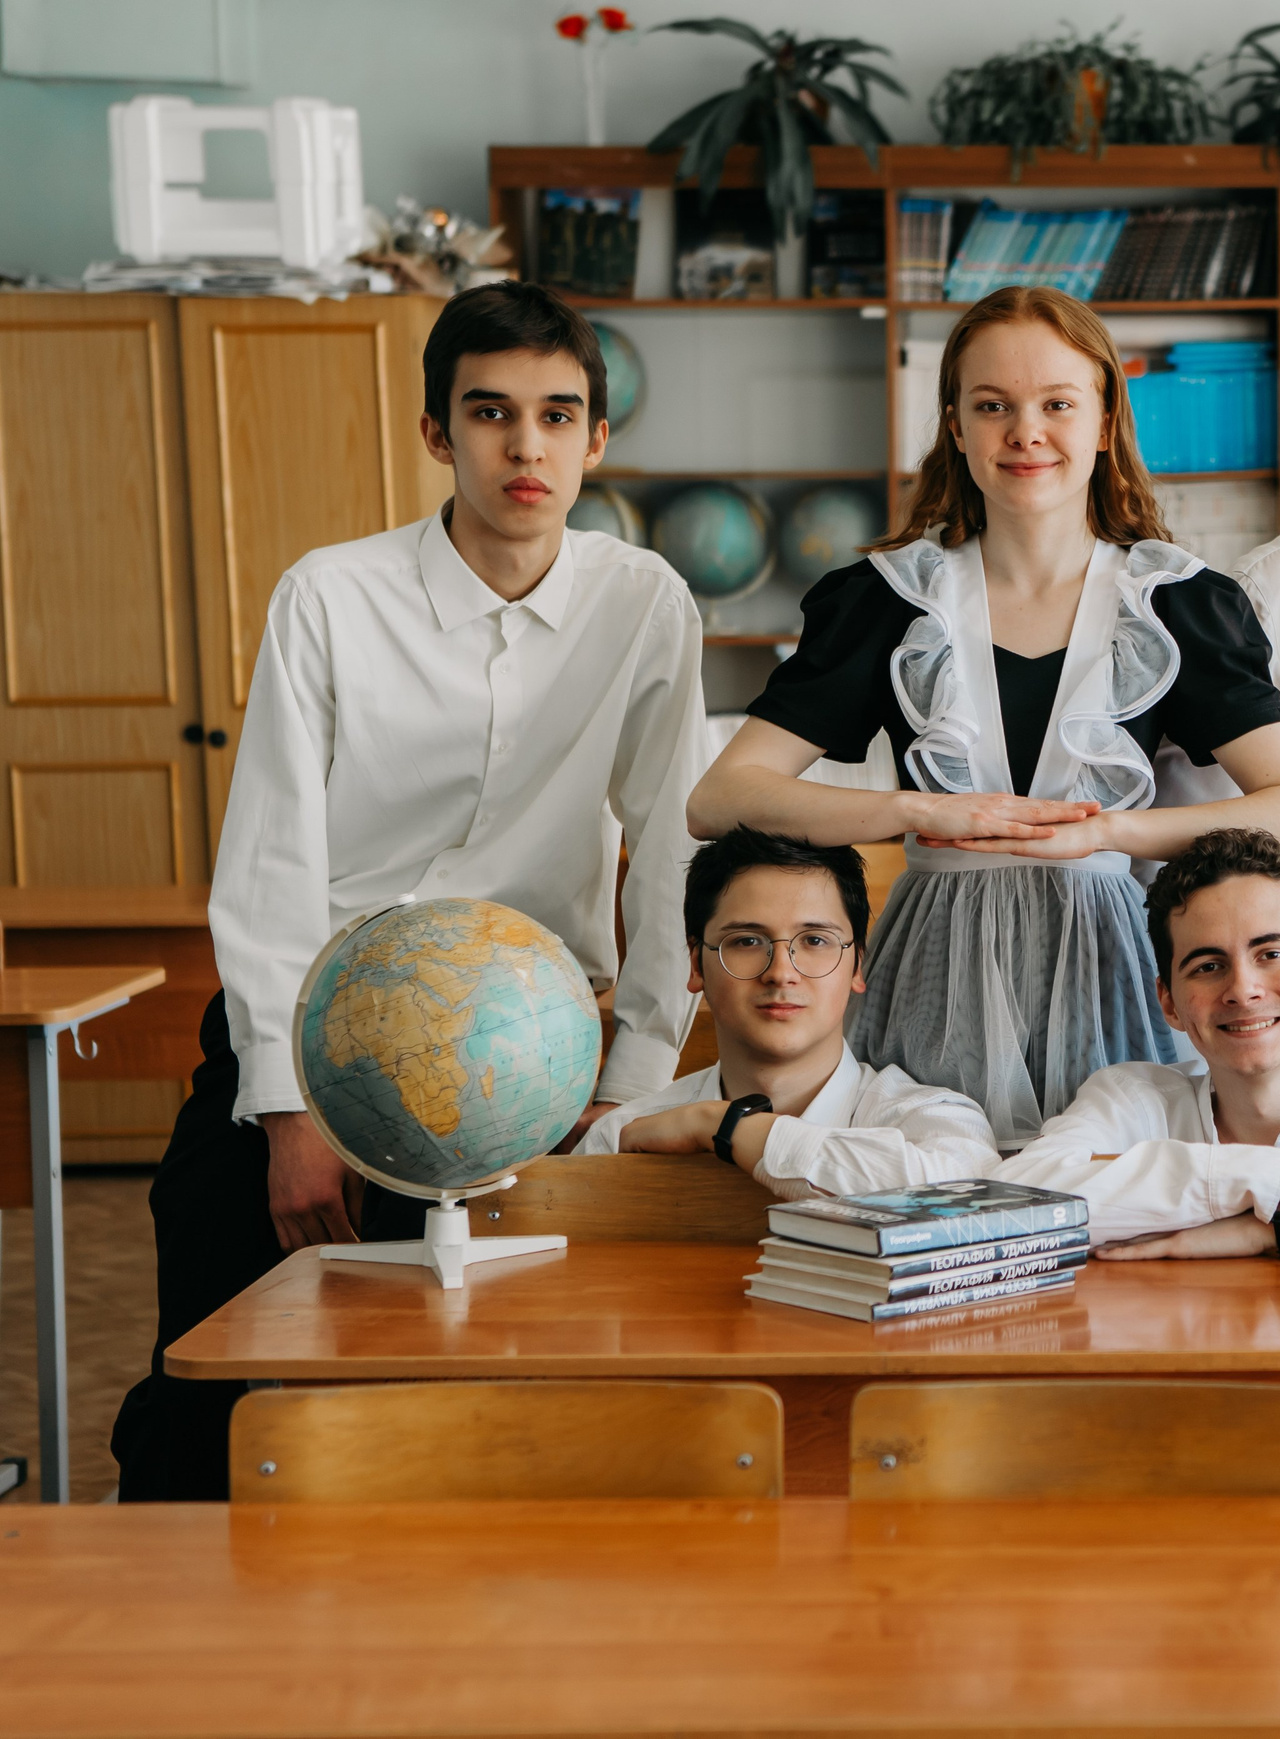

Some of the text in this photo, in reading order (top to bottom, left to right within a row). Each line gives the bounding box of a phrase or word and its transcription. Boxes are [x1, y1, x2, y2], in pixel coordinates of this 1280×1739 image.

[1052, 1206, 1067, 1227] 10
[889, 1231, 932, 1245] География
[930, 1236, 1061, 1272] ГЕОГРАФИЯ УДМУРТИИ
[928, 1258, 1059, 1295] ГЕОГРАФИЯ УДМУРТИИ
